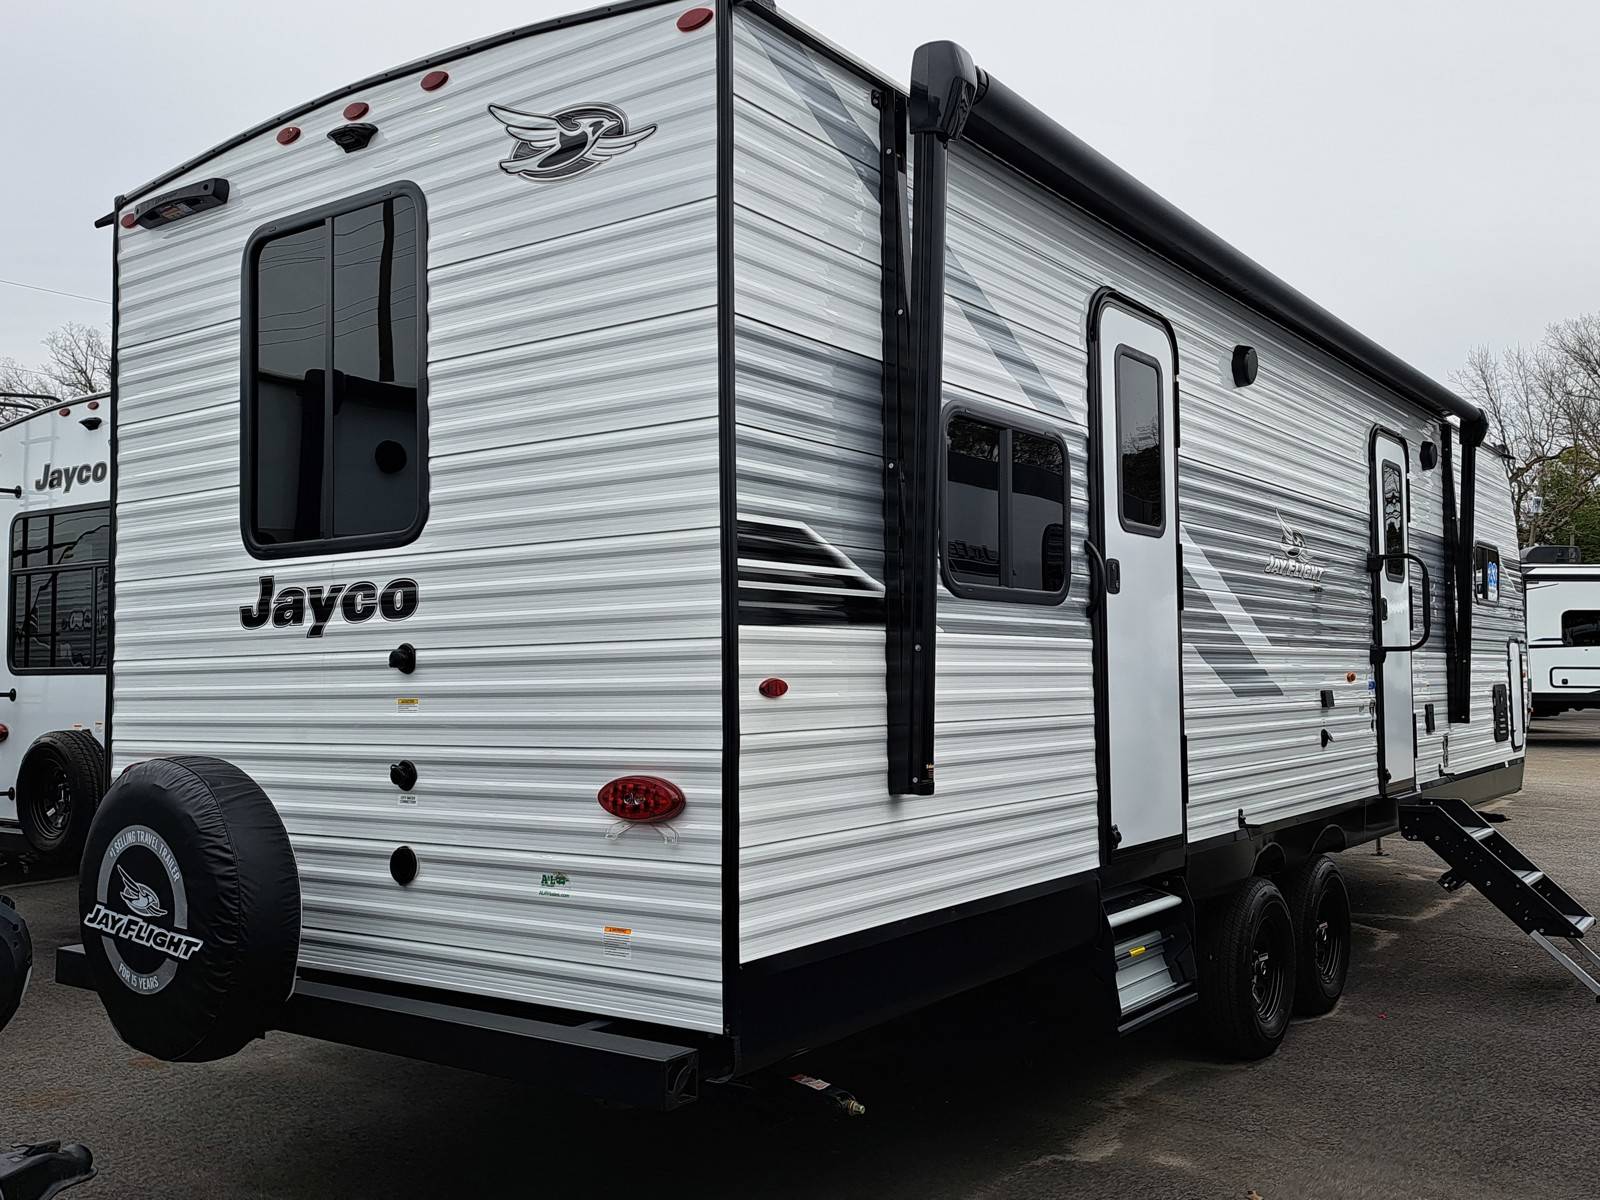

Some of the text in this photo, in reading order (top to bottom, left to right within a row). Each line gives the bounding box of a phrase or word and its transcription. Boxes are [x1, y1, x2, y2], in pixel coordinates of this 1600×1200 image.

[34, 461, 108, 494] Jayco
[240, 575, 419, 638] Jayco
[114, 830, 136, 853] SELLING
[137, 830, 159, 850] TRAVEL
[158, 843, 181, 882] TRAILER
[118, 962, 159, 990] FOR 15 YEARS
